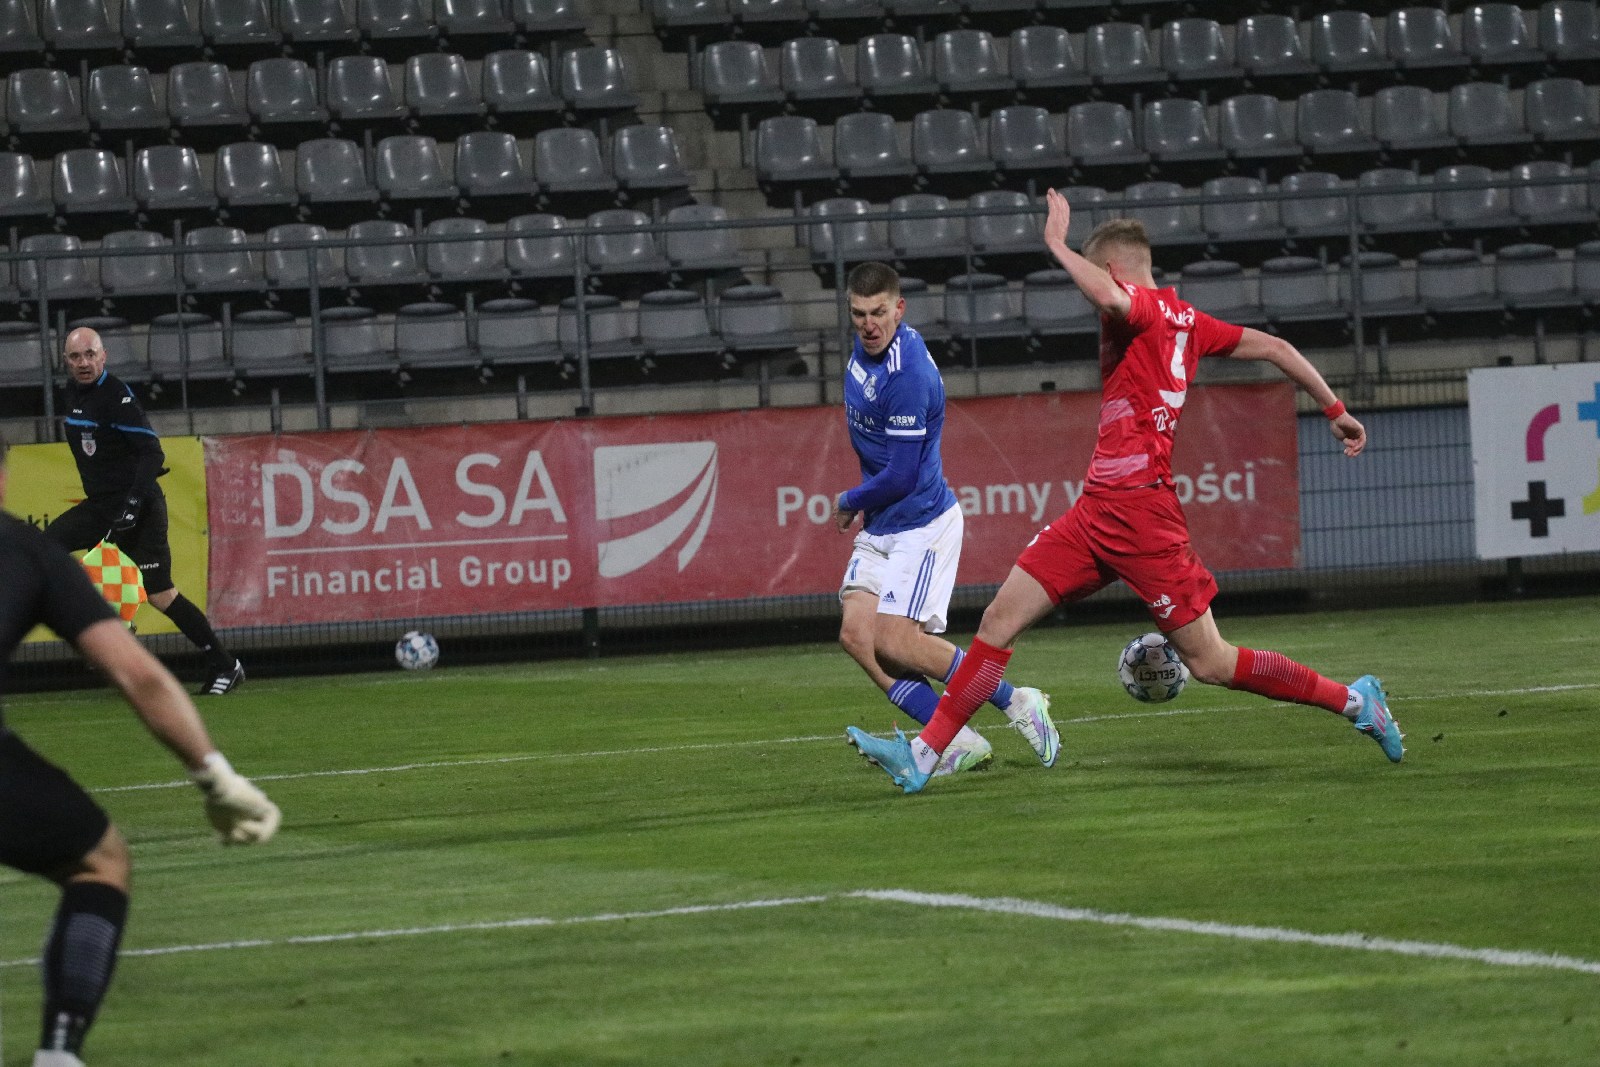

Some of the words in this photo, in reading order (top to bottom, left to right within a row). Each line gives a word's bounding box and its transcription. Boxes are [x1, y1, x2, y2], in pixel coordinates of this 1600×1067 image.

[261, 456, 433, 539] DSA
[455, 449, 567, 528] SA
[266, 557, 443, 598] Financial
[459, 555, 572, 590] Group
[1139, 668, 1176, 682] SELECT
